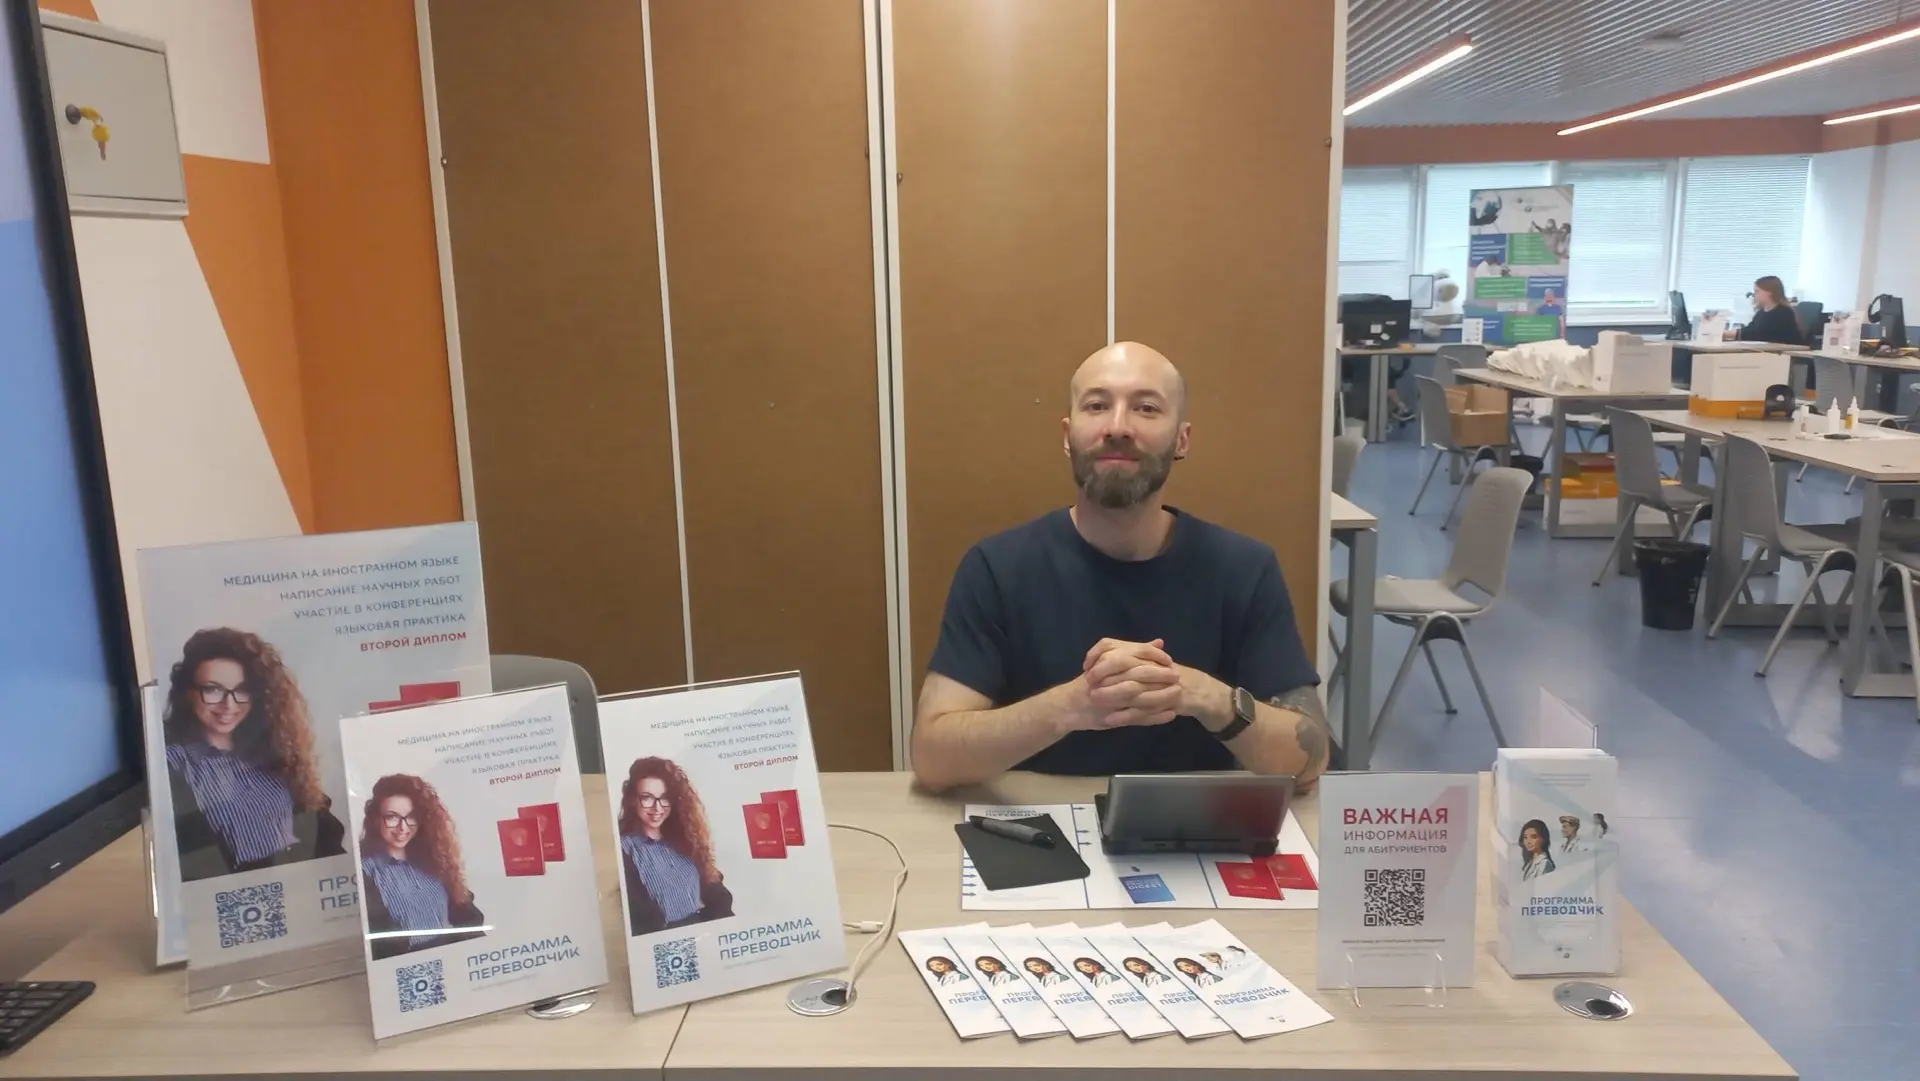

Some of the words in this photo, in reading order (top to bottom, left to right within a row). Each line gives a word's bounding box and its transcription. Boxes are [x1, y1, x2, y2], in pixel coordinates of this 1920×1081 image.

[223, 571, 298, 586] МЕДИЦИНА
[301, 570, 319, 579] НА
[322, 560, 417, 577] ИНОСТРАННОМ
[421, 556, 459, 567] ЯЗЫКЕ
[279, 585, 357, 601] НАПИСАНИЕ
[361, 580, 420, 592] НАУЧНЫХ
[424, 575, 461, 586] РАБОТ
[294, 606, 350, 620] УЧАСТИЕ
[355, 604, 362, 614] В
[366, 594, 463, 612] КОНФЕРЕНЦИЯХ
[334, 620, 399, 636] ЯЗЫКОВАЯ
[403, 613, 465, 628] ПРАКТИКА
[360, 638, 410, 652] ВТОРОЙ
[414, 632, 466, 647] ДИПЛОМ
[463, 720, 525, 735] ИНОСТРАННОМ
[734, 761, 764, 771] ВТОРОЙ
[766, 755, 798, 766] ДИПЛОМ
[489, 774, 522, 785] ВТОРОЙ
[525, 767, 561, 780] ДИПЛОМ
[1343, 808, 1448, 825] ВАЖНАЯ
[1344, 829, 1448, 841] ИНФОРМАЦИЯ
[1344, 846, 1365, 854] ДЛЯ
[1368, 845, 1447, 854] АБИТУРИЕНТОВ
[1531, 896, 1594, 905] ПРОГРАММА
[1521, 906, 1604, 916] ПЕРЕВОДЧИК
[718, 917, 813, 945] ПРОГРАММА
[467, 935, 572, 967] ПРОГРАММА
[720, 930, 821, 960] ПЕРЕВОДЧИК
[469, 947, 580, 981] ПЕРЕВОДЧИК
[1214, 988, 1290, 1006] ПЕРЕВОДЧИК
[1216, 986, 1276, 1000] ПРОГРАММА
